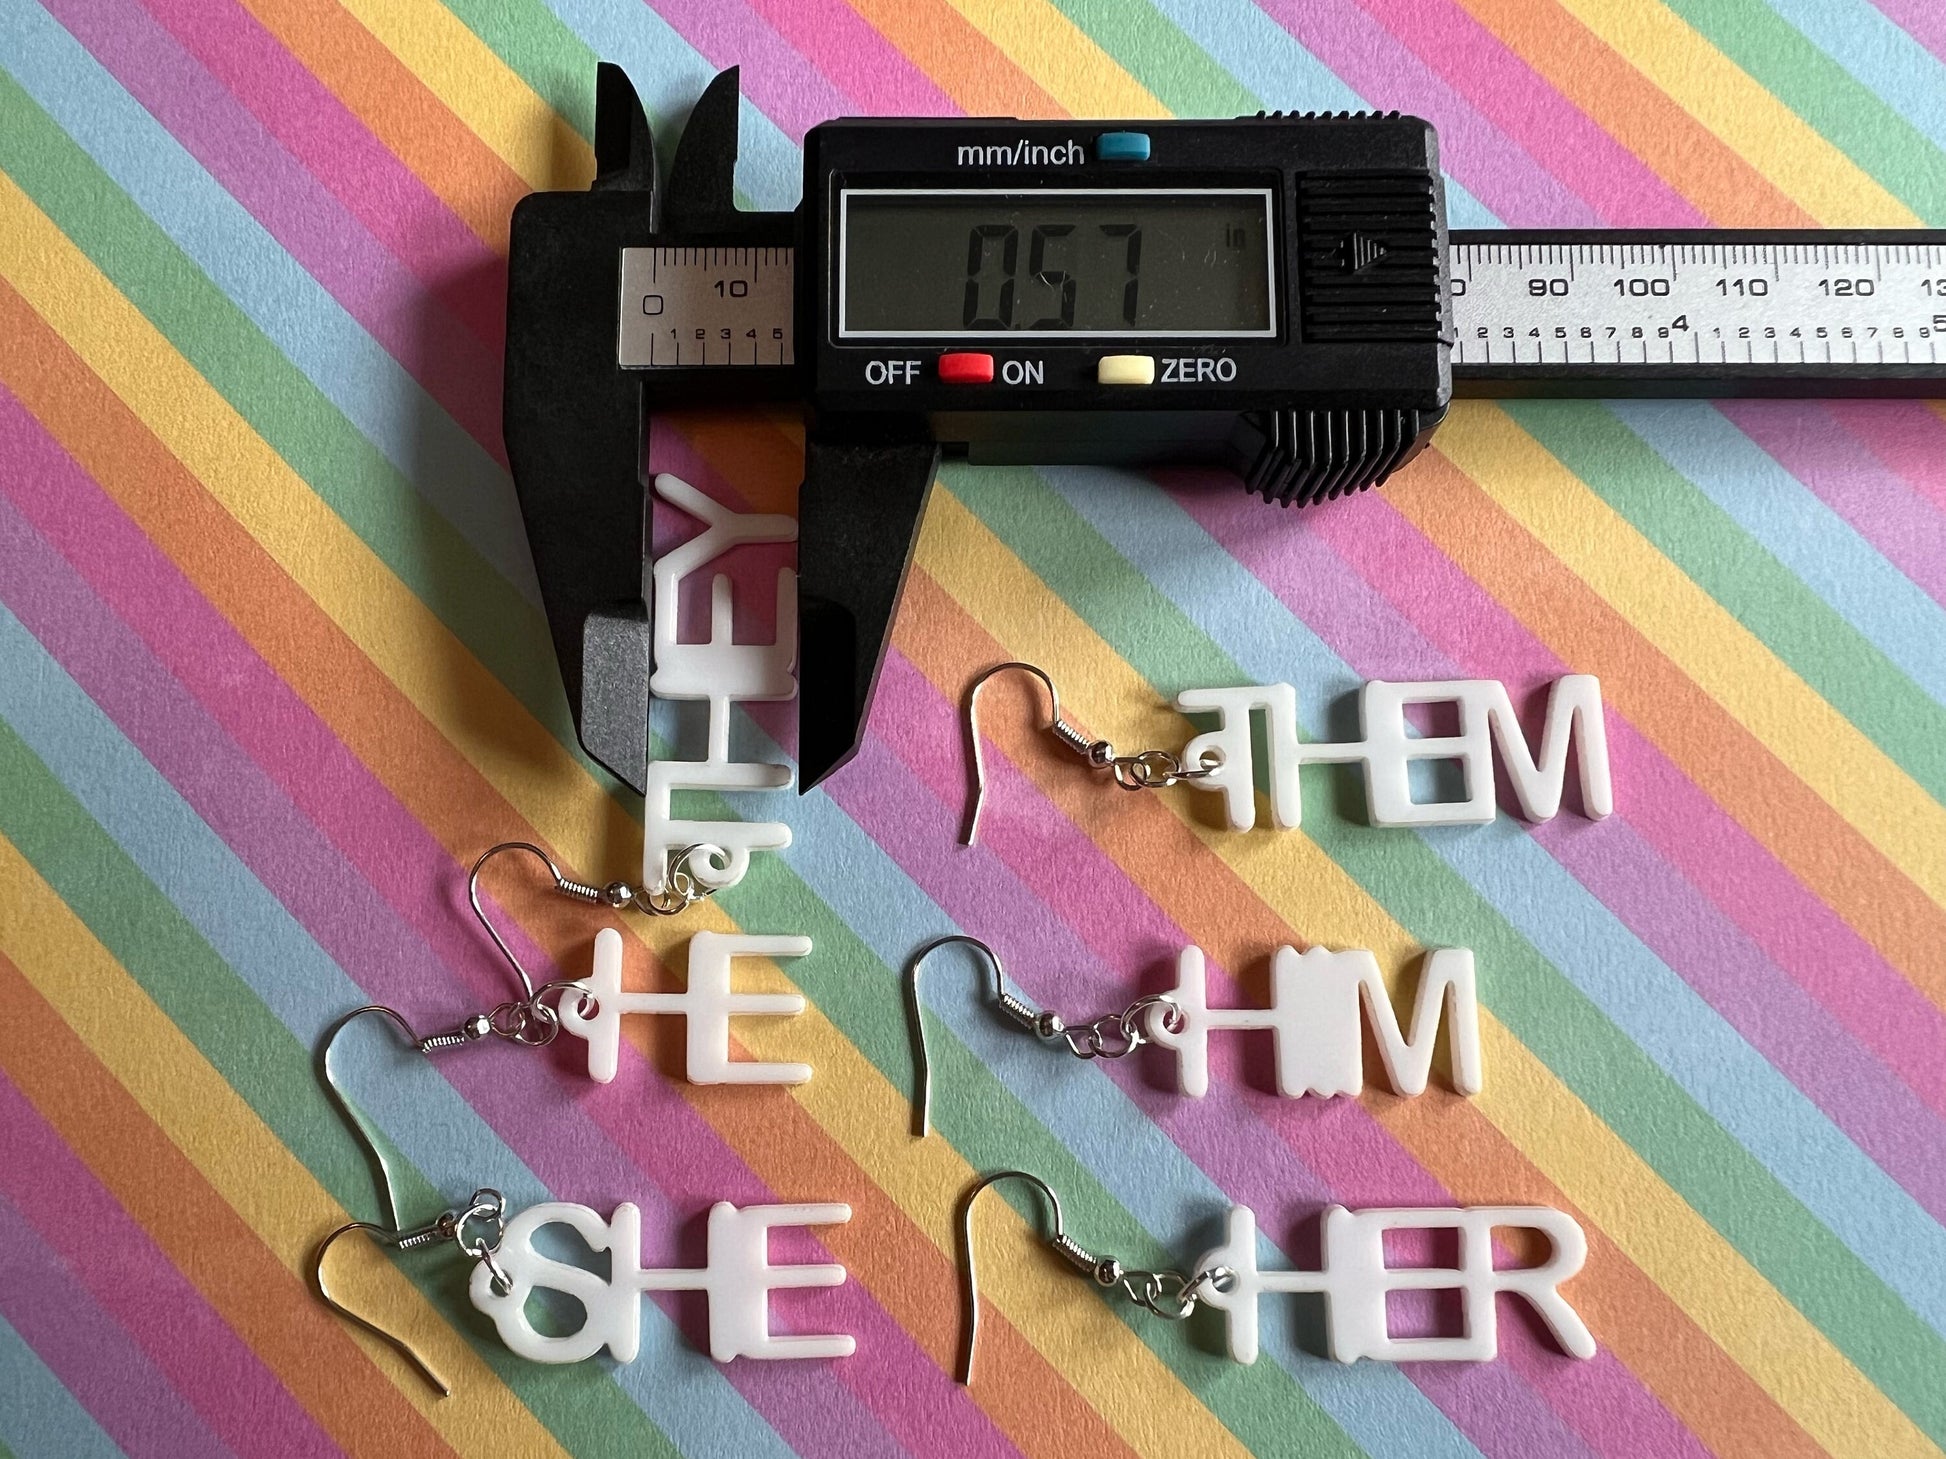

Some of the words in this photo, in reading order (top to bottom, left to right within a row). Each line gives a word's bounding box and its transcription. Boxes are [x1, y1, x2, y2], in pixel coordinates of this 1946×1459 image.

[956, 138, 1085, 166] mm/inch
[714, 279, 749, 299] 10
[1527, 278, 1569, 298] 90
[1613, 278, 1671, 298] 100
[1715, 278, 1769, 298] 110
[1817, 278, 1875, 298] 120
[642, 294, 664, 316] 0
[670, 328, 677, 340] 1
[695, 328, 706, 340] 2
[720, 328, 731, 340] 3
[745, 328, 757, 340] 4
[772, 328, 783, 340] 5
[1476, 326, 1489, 337] 2
[1502, 326, 1515, 337] 3
[1527, 326, 1541, 337] 4
[1554, 326, 1567, 337] 5
[1580, 326, 1592, 337] 6
[1604, 326, 1617, 337] 7
[1631, 326, 1644, 337] 8
[1657, 326, 1670, 337] 9
[1672, 314, 1690, 334] 4
[865, 360, 922, 385] OFF
[1001, 359, 1044, 385] ON
[1160, 357, 1238, 384] ZERO
[643, 473, 799, 897] THEY
